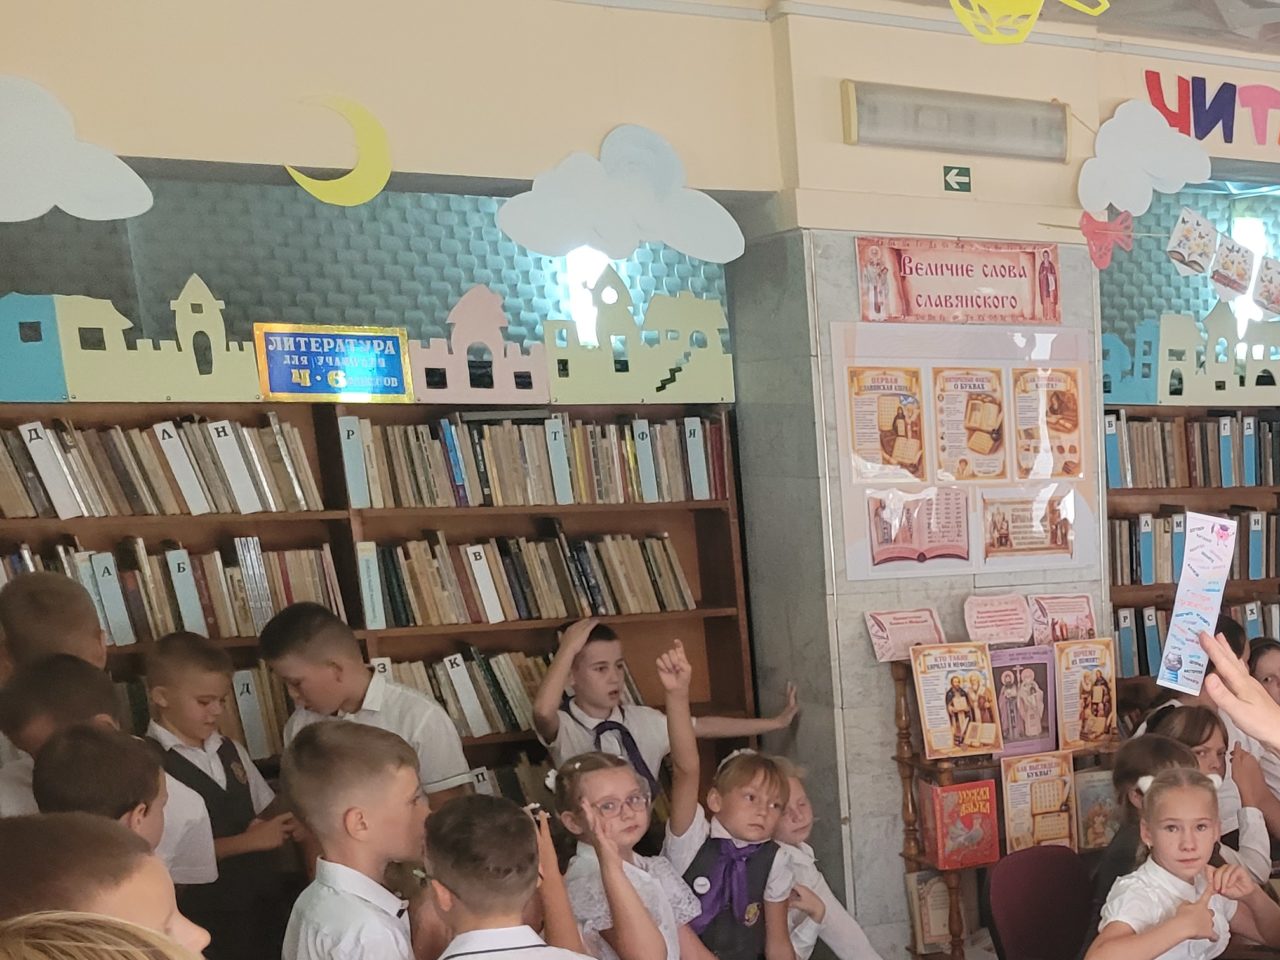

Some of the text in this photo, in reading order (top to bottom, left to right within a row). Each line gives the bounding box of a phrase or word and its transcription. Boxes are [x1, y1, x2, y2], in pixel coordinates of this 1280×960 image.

[268, 336, 396, 355] ЛИТЕРАТУРА
[327, 369, 347, 388] 6
[27, 427, 43, 443] Д
[160, 427, 175, 441] Л
[216, 425, 230, 439] Н
[346, 429, 355, 441] Р
[551, 430, 560, 441] Т
[637, 430, 648, 441] Ф
[687, 428, 697, 439] Я
[472, 550, 483, 561] В
[101, 565, 113, 577] А
[176, 562, 186, 574] Б
[449, 657, 461, 669] К
